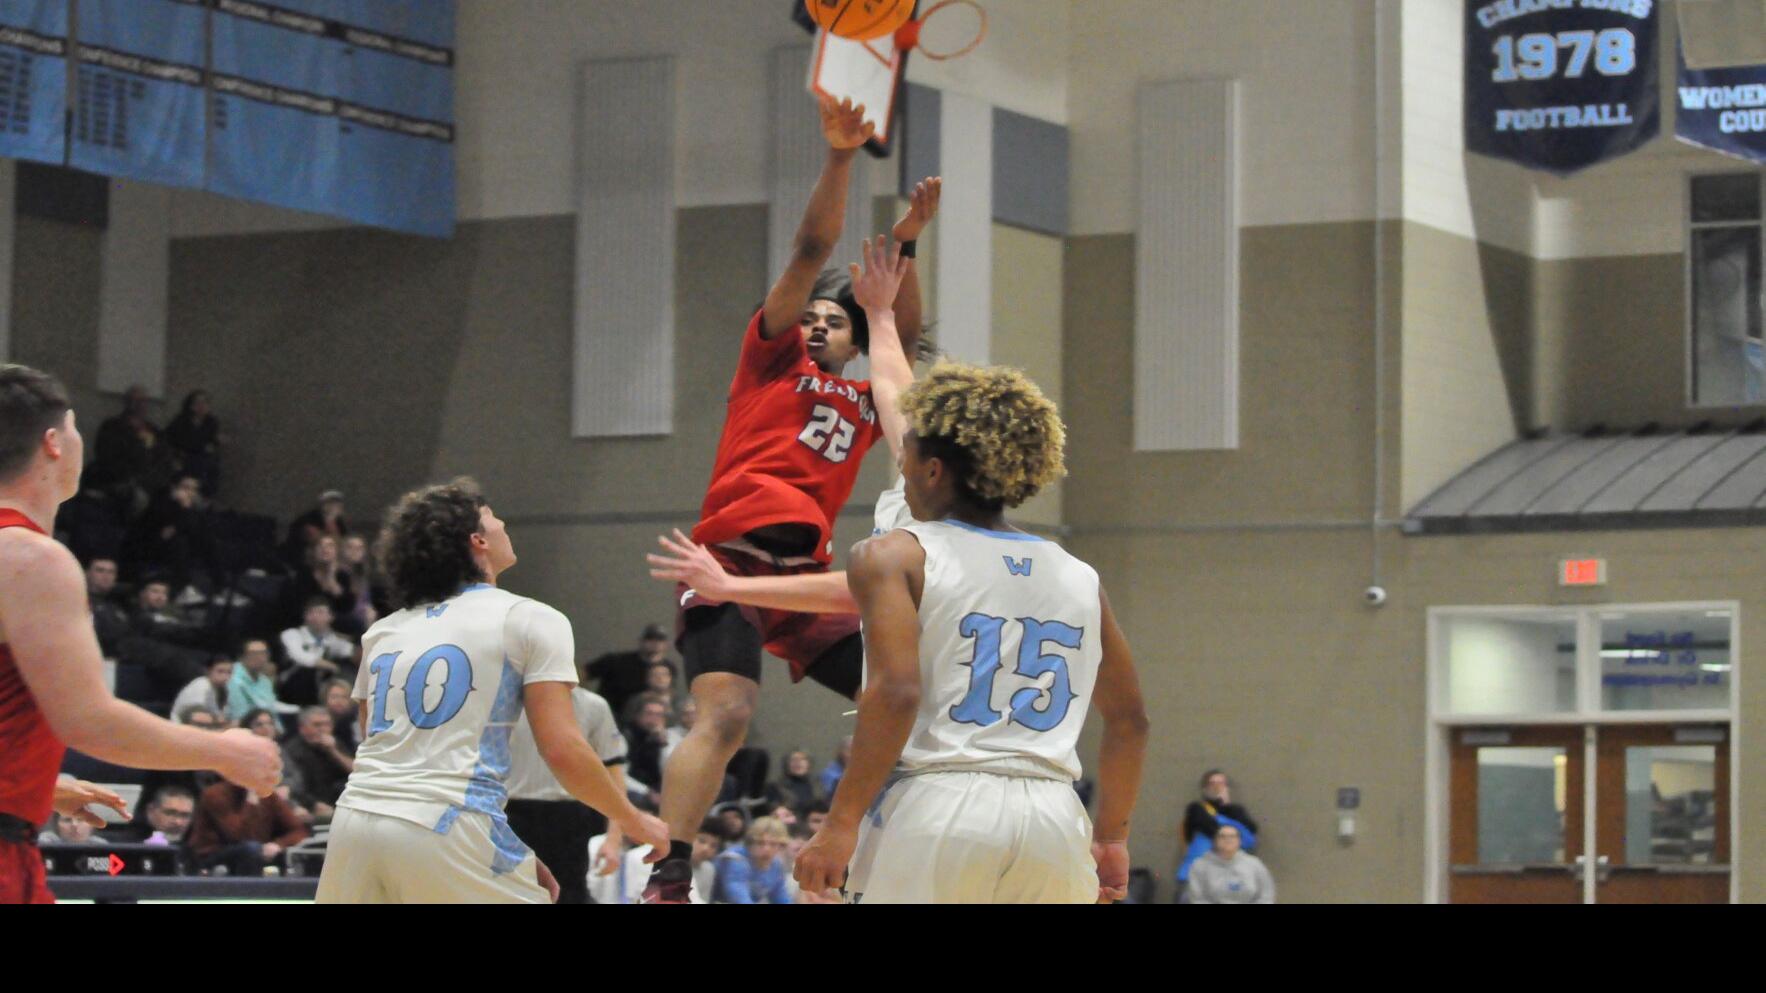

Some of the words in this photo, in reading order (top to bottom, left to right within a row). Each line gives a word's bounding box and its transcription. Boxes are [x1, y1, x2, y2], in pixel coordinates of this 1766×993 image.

[1491, 27, 1636, 83] 1978
[1495, 103, 1633, 131] FOOTBALL
[798, 404, 856, 463] 22
[1002, 555, 1033, 577] W
[367, 643, 478, 738] 10
[948, 612, 1085, 733] 15
